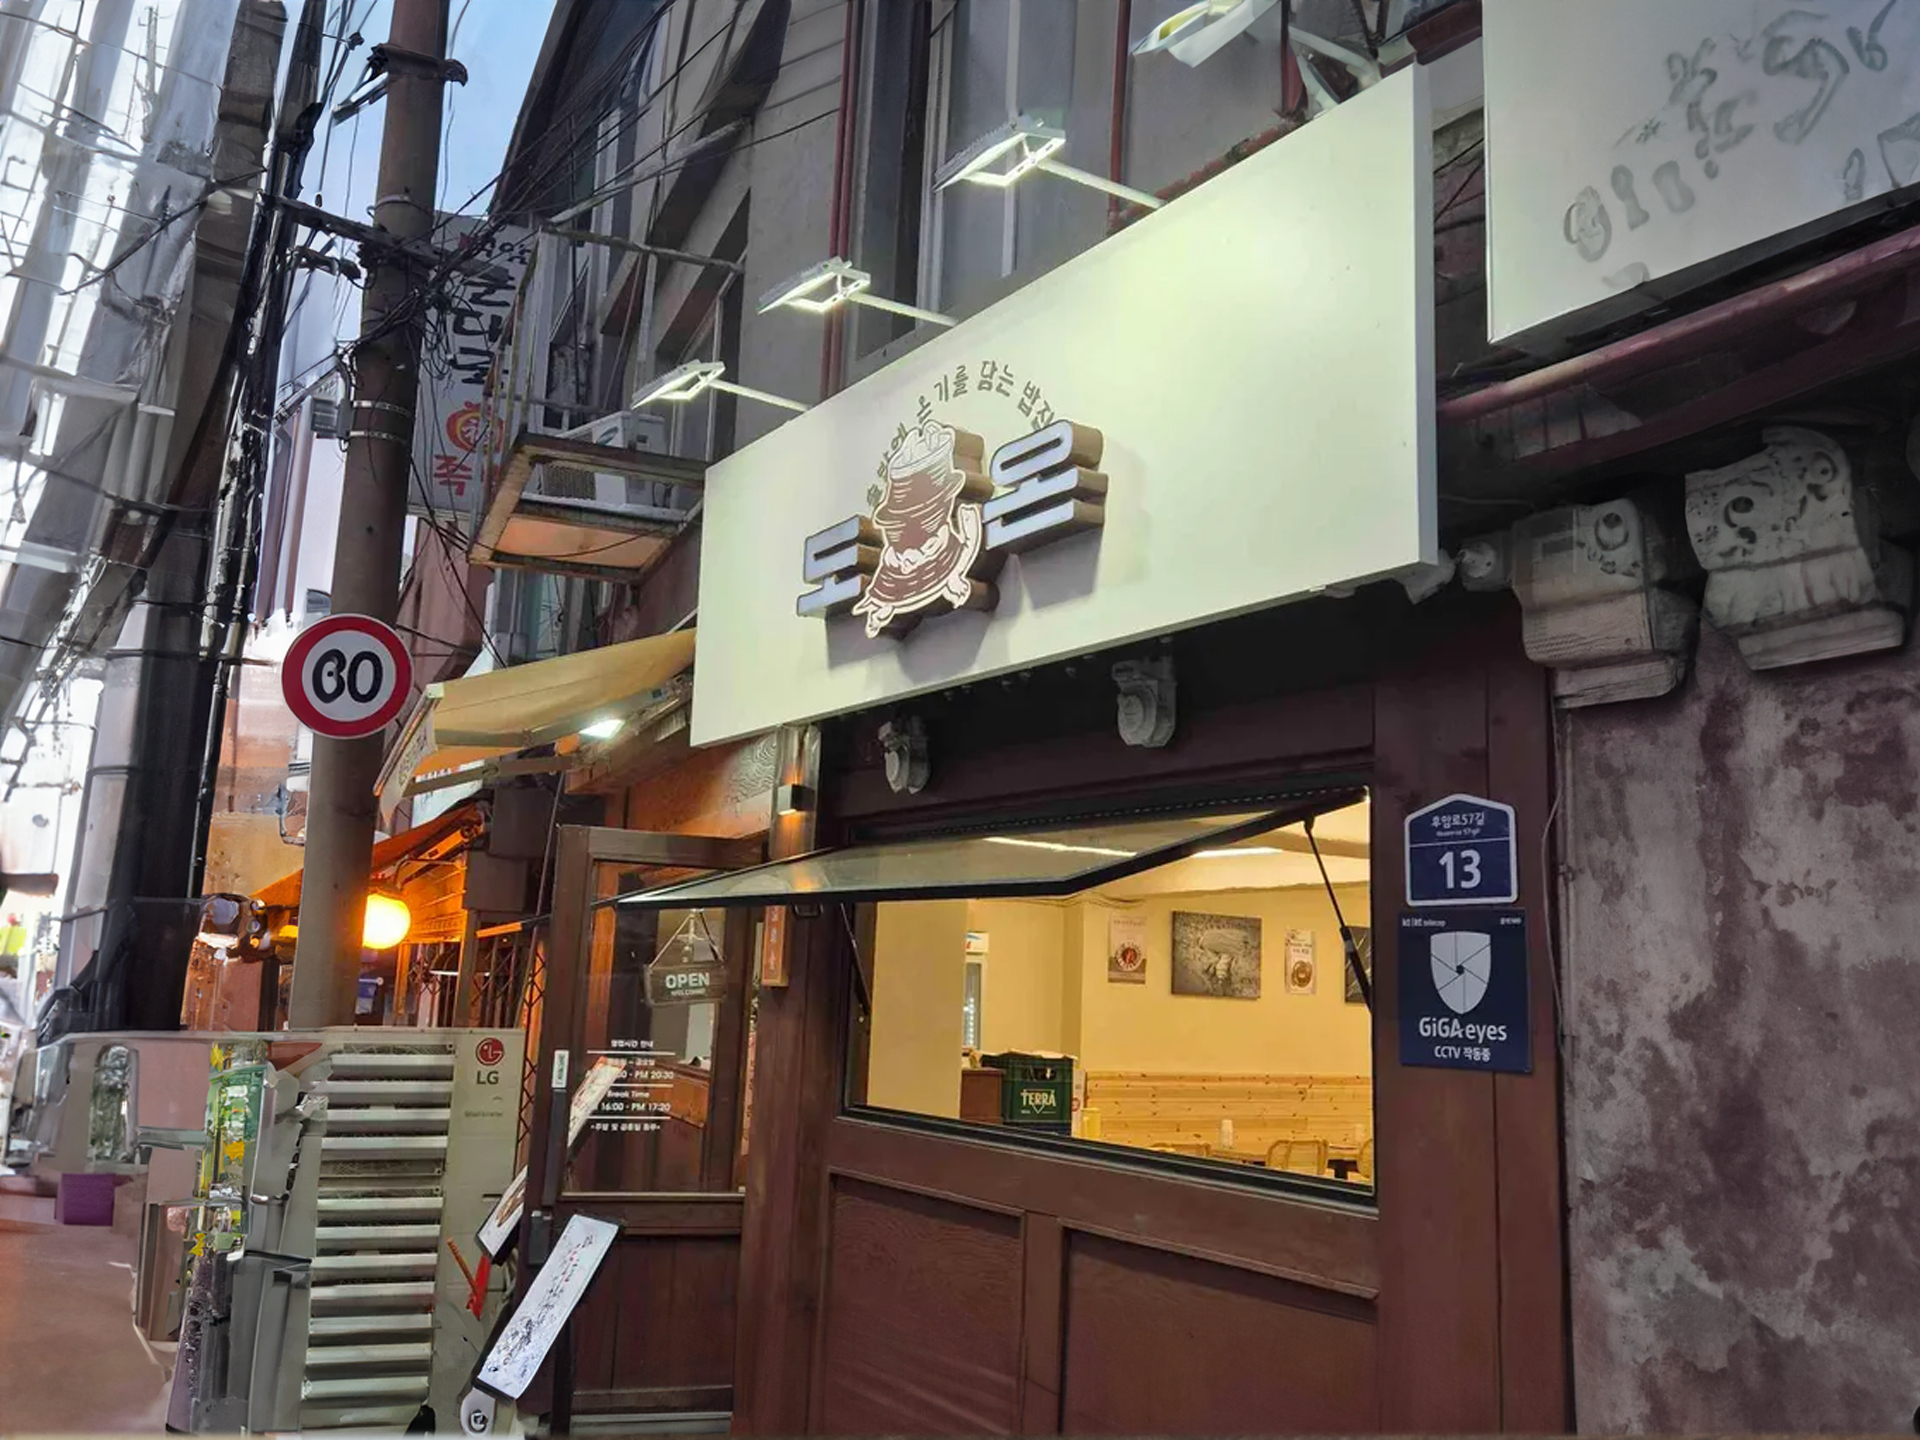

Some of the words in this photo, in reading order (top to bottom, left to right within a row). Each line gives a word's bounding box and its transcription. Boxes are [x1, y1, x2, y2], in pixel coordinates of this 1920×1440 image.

[977, 359, 1015, 398] 담는
[1438, 849, 1482, 889] 13
[665, 972, 710, 989] OPEN
[1434, 1045, 1461, 1060] CCTV
[1462, 1046, 1491, 1063] 작동중
[476, 1070, 500, 1085] LG
[1020, 1088, 1057, 1108] TERRA
